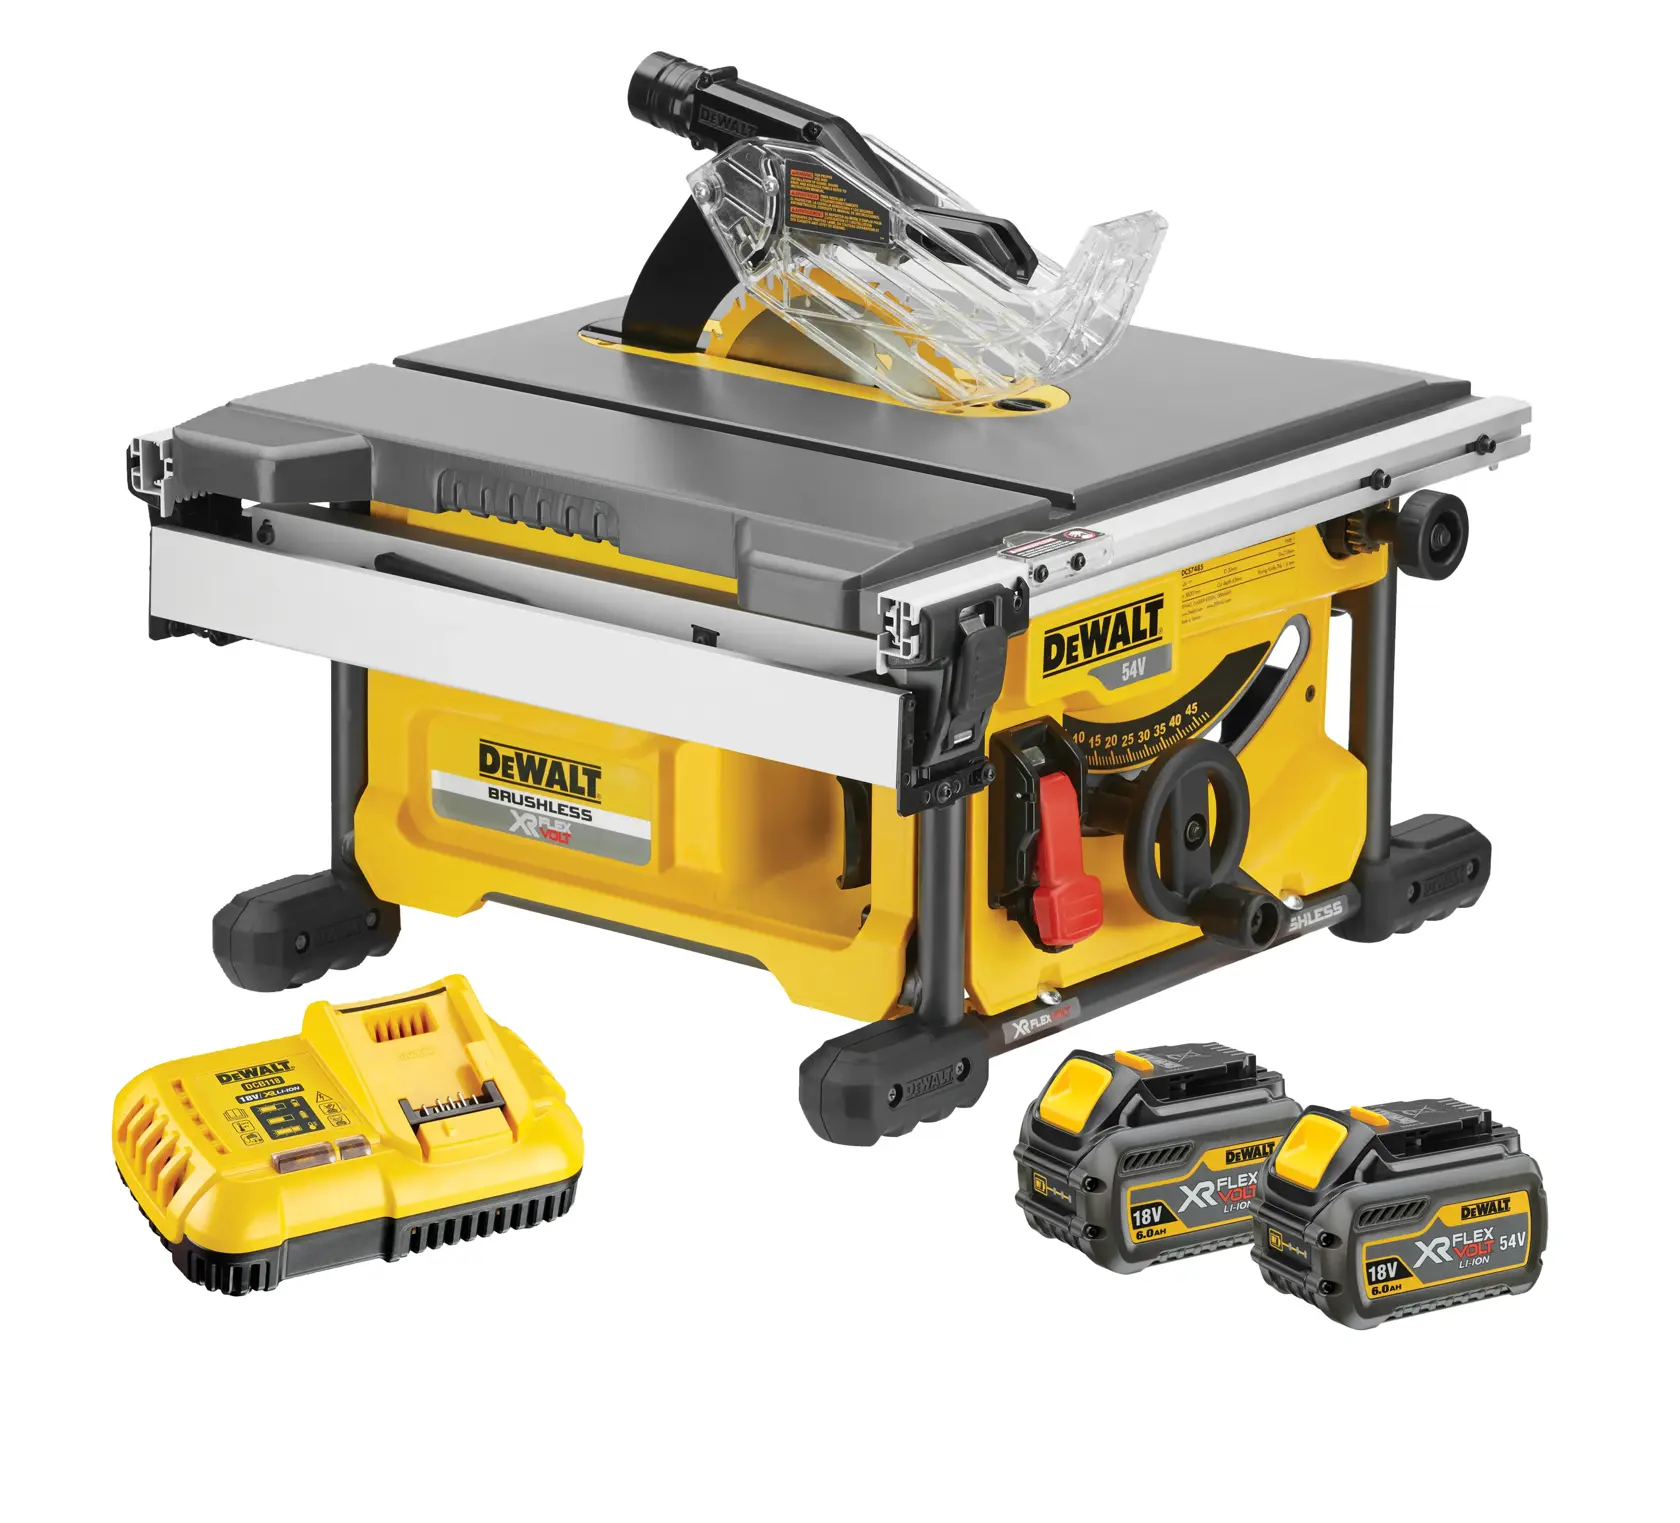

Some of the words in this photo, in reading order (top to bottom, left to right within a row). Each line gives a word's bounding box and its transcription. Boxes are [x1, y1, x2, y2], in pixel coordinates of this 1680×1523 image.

[1122, 657, 1147, 682] 54V
[1073, 731, 1085, 744] 10
[1088, 734, 1101, 748] 15
[1105, 734, 1117, 749] 20
[1122, 733, 1134, 747] 25
[1138, 729, 1150, 743] 30
[1153, 722, 1166, 737] 35
[1168, 714, 1181, 727] 40
[1185, 702, 1198, 716] 45
[488, 786, 593, 822] BRUSHLESS
[508, 809, 540, 838] XR
[538, 816, 572, 834] FLEX
[540, 826, 572, 845] VOLT
[1012, 1018, 1031, 1040] XR
[1030, 1014, 1053, 1030] FLEX
[1049, 1005, 1072, 1020] VOLT
[245, 1077, 281, 1090] DCB118
[239, 1092, 259, 1103] 18V
[1178, 1180, 1218, 1213] XR
[1217, 1171, 1258, 1191] FLEX
[1217, 1184, 1257, 1203] VOLT
[1133, 1206, 1163, 1226] 18V
[1413, 1236, 1453, 1269] XR
[1453, 1227, 1494, 1248] FLEX
[1500, 1231, 1526, 1252] 54V
[1453, 1239, 1495, 1259] VOLT
[1368, 1262, 1398, 1282] 18V
[1459, 1255, 1491, 1269] LI-ION
